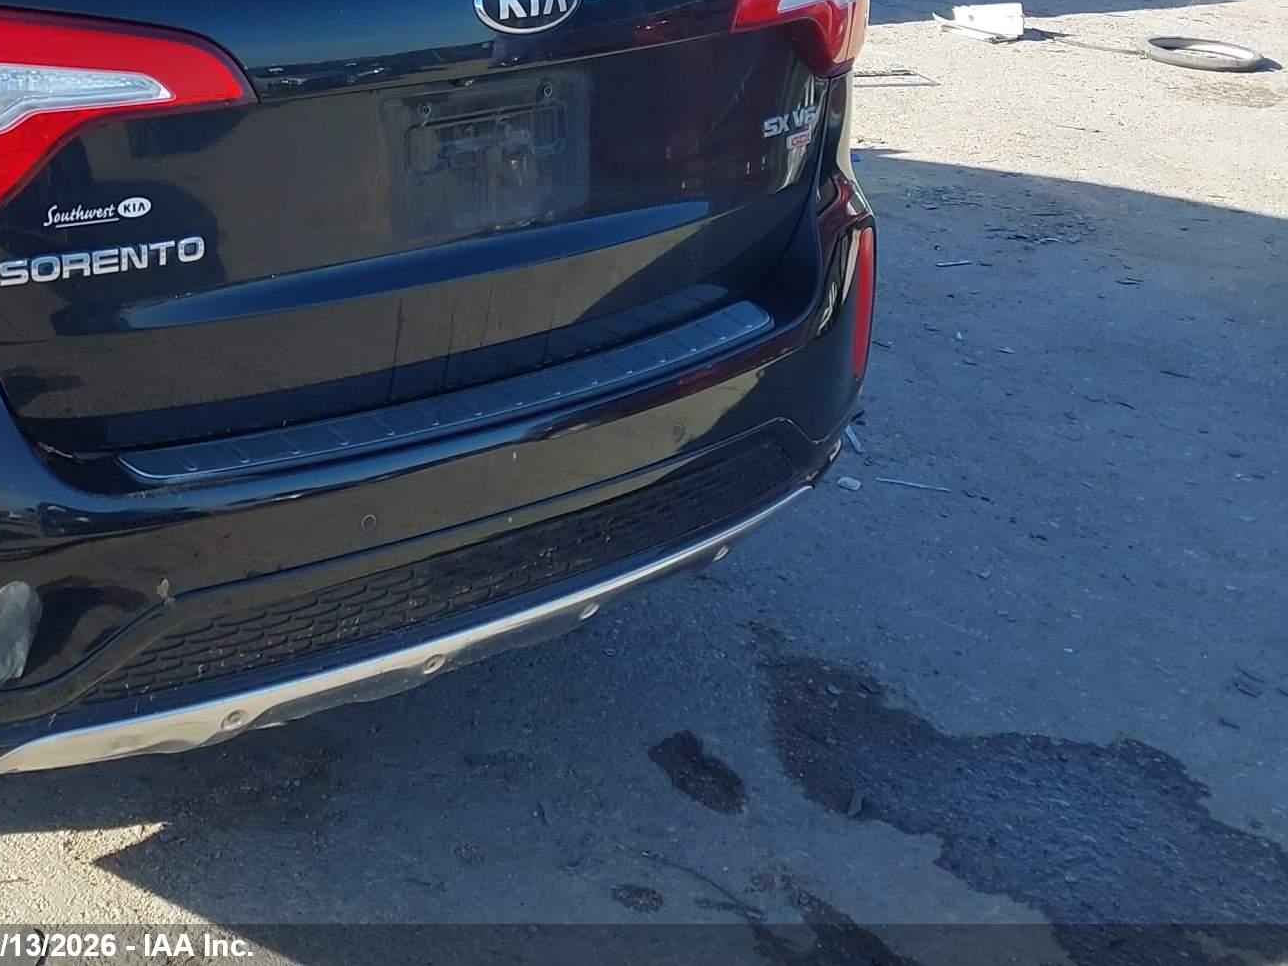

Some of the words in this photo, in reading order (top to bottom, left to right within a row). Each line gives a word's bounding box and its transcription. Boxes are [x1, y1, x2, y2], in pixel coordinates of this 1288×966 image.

[764, 114, 790, 138] SX
[792, 105, 817, 127] V6
[43, 203, 116, 227] Southwest
[123, 202, 146, 214] KIA
[0, 236, 206, 287] SORENTO
